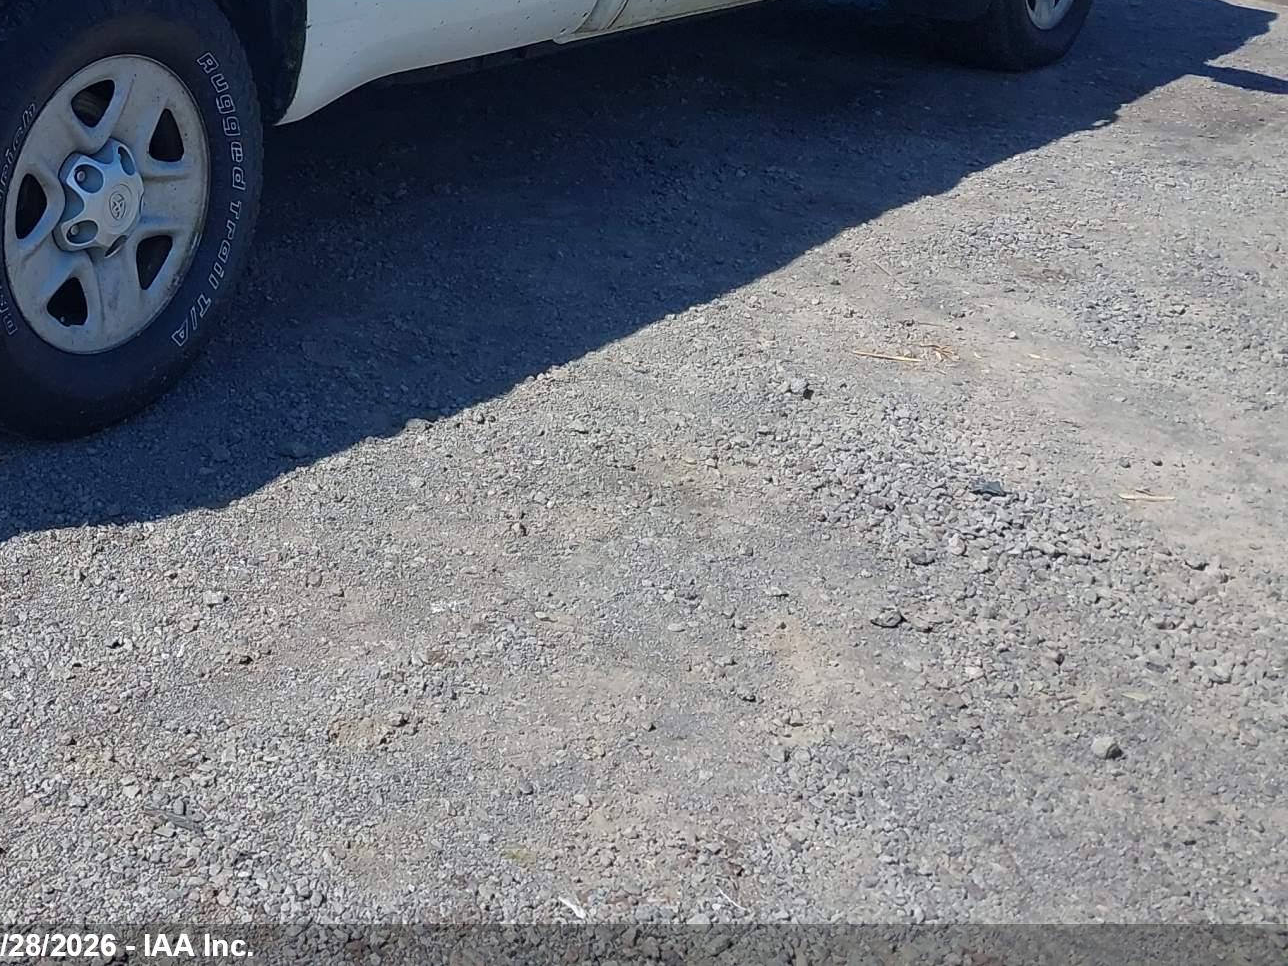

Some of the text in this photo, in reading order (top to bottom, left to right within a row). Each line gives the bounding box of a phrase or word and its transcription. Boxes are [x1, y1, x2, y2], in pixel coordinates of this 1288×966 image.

[172, 52, 246, 347] Rugged Trail T/A
